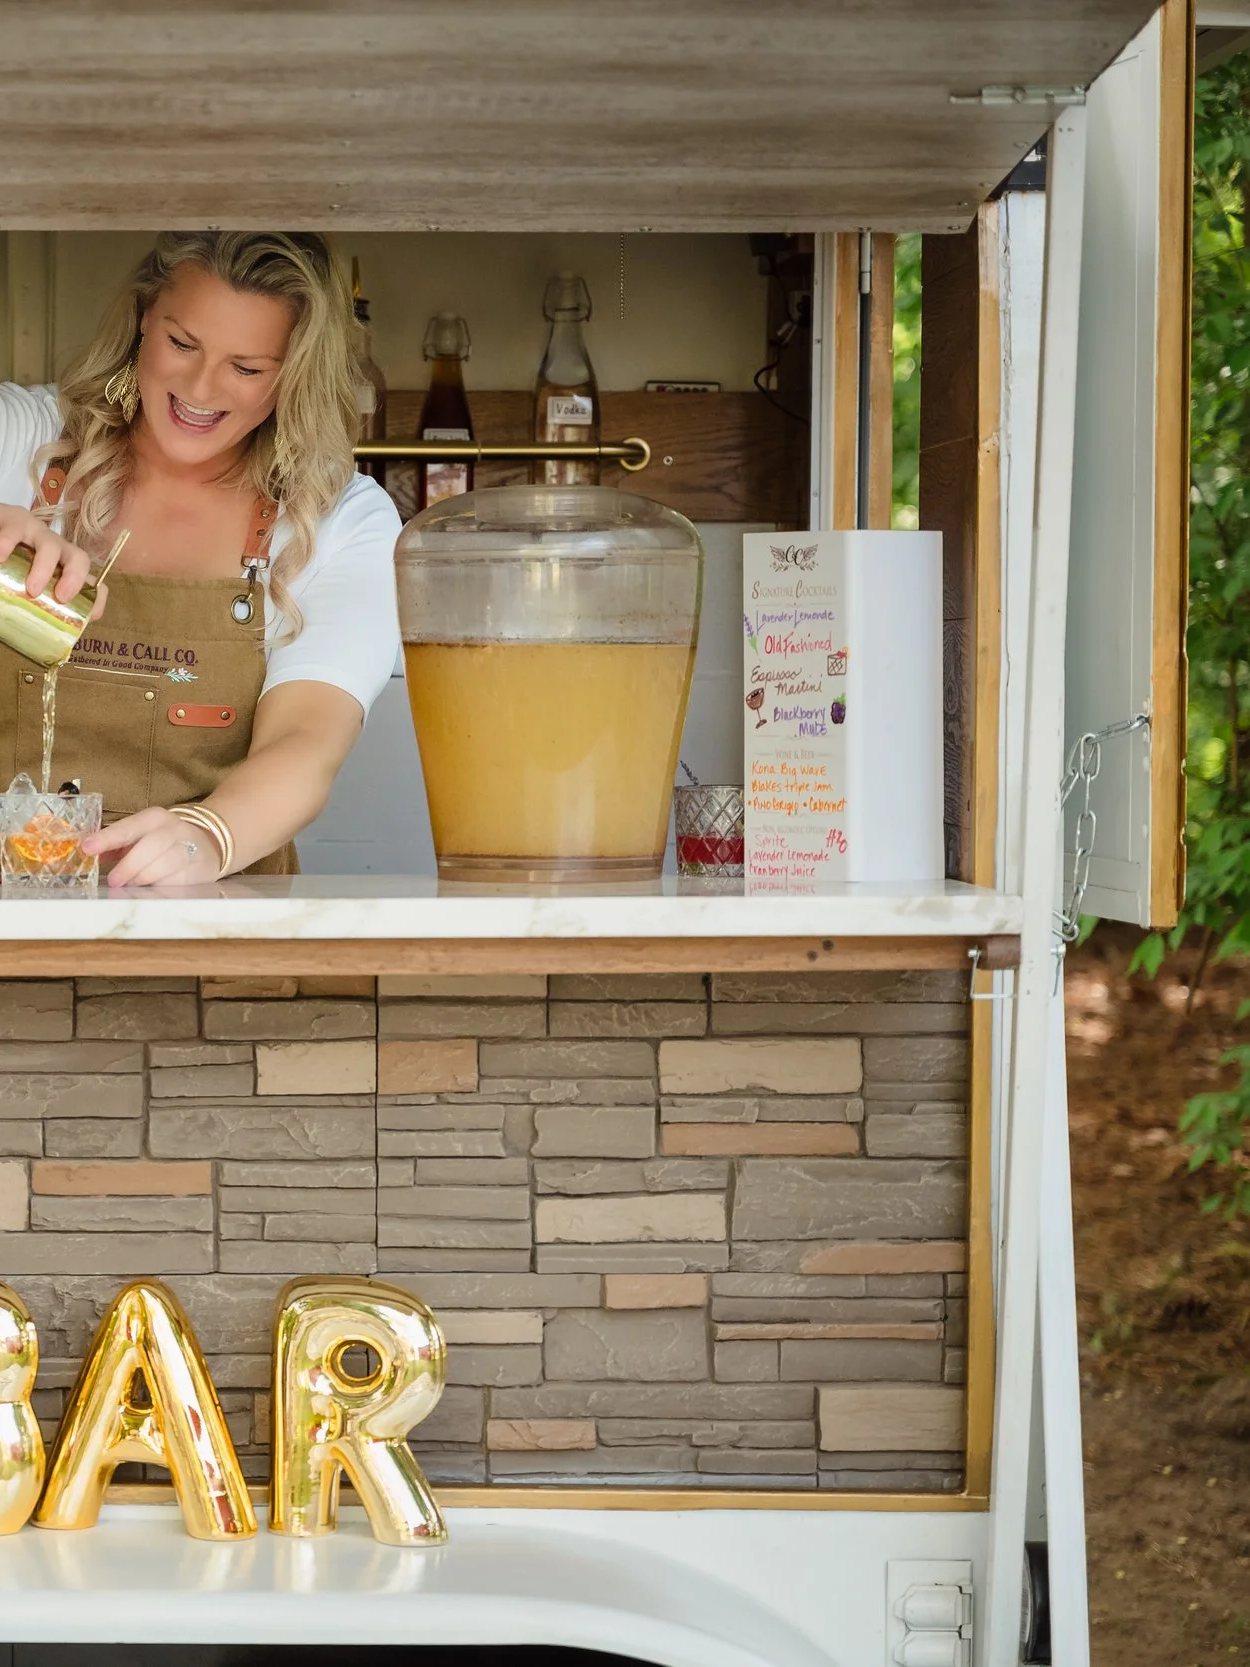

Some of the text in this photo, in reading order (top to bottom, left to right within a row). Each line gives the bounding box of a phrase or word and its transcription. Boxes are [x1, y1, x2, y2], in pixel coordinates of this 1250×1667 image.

[556, 403, 587, 415] Vodka
[117, 643, 129, 656] &
[111, 660, 132, 670] Good
[134, 662, 169, 674] Company
